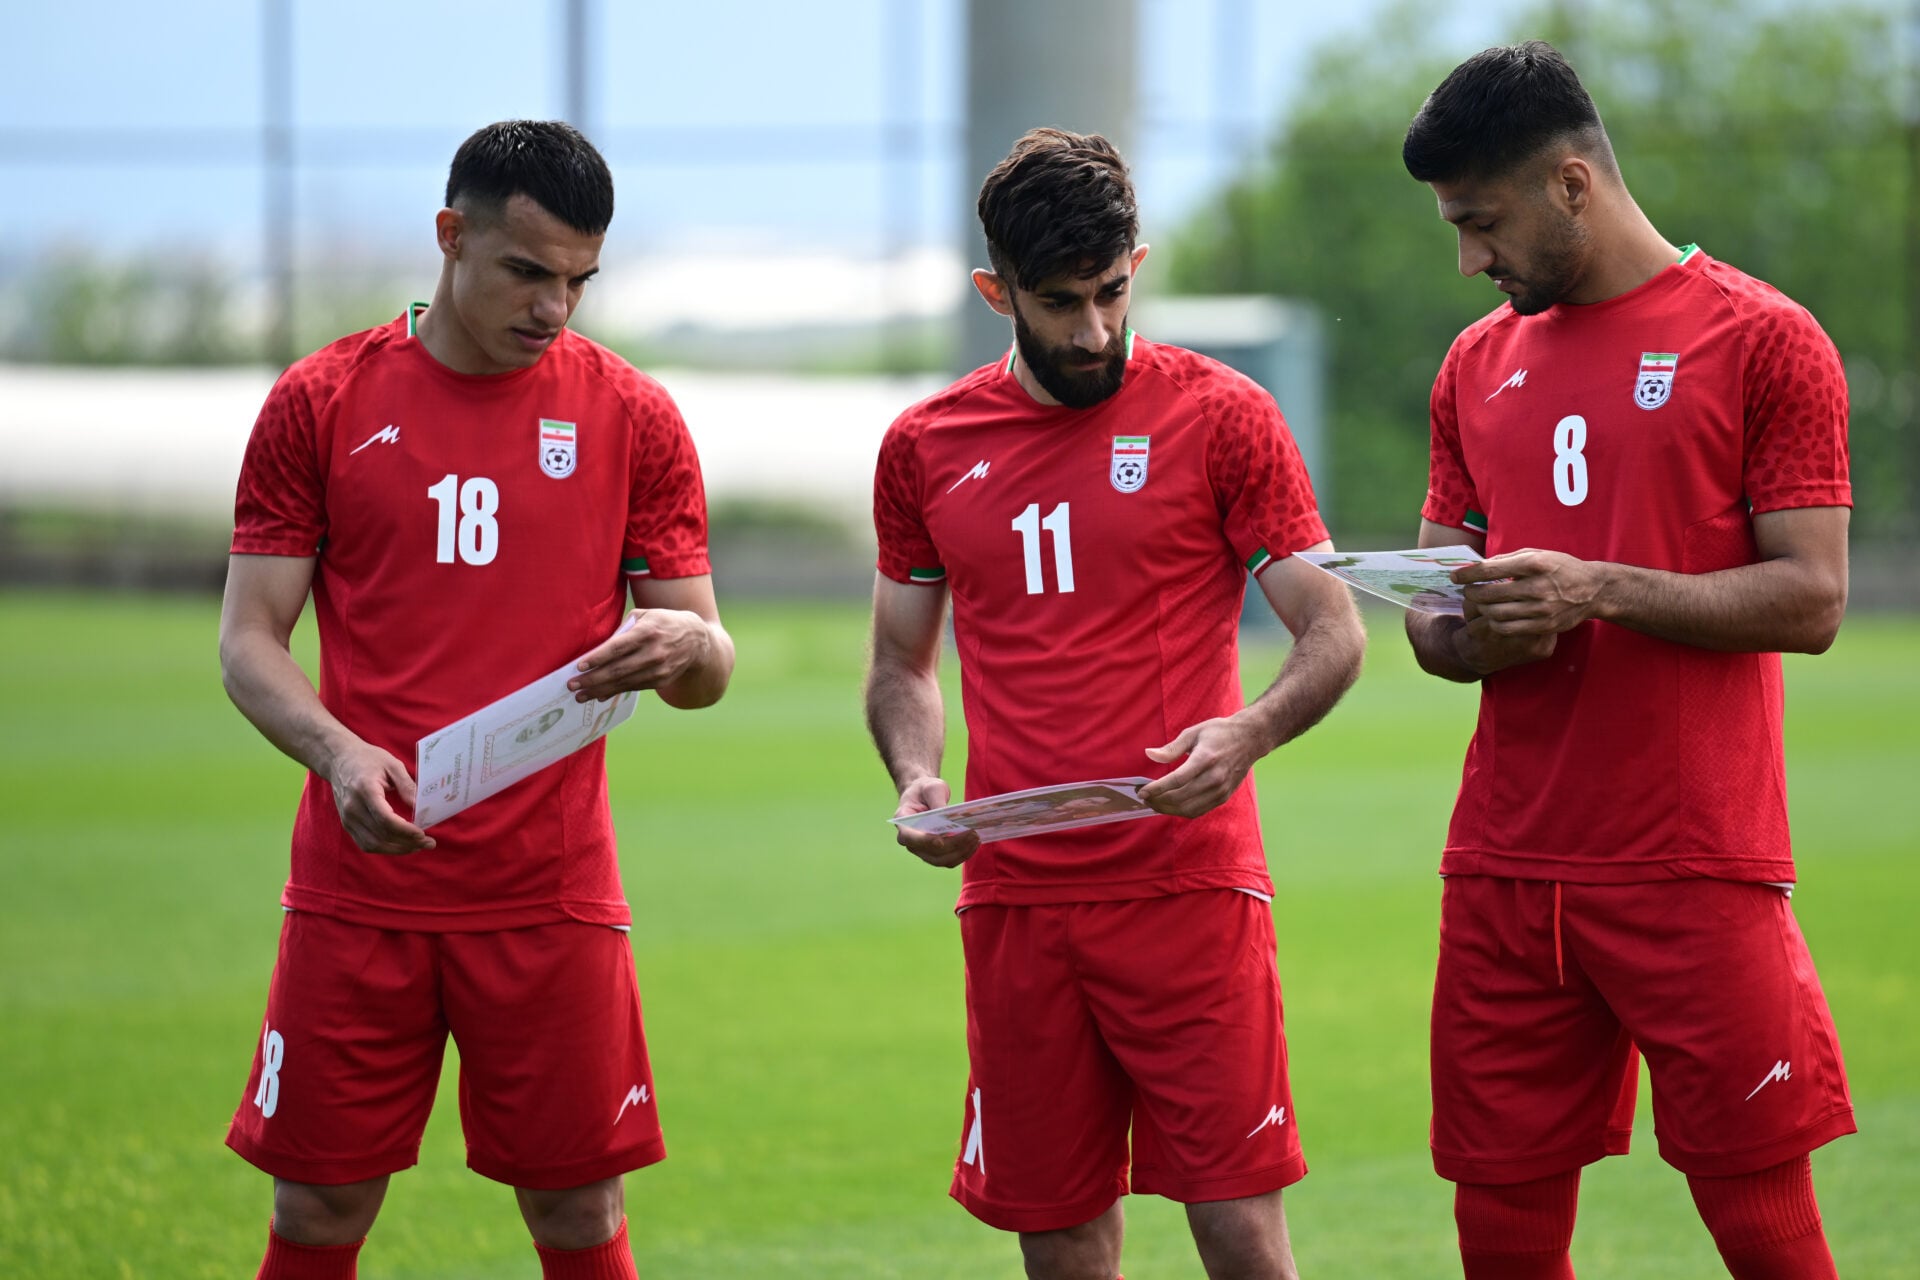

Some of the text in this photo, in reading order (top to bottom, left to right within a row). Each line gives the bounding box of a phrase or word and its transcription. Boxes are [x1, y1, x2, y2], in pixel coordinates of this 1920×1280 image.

[1552, 414, 1589, 507] 8
[428, 474, 499, 566] 18
[1011, 502, 1075, 594] 11
